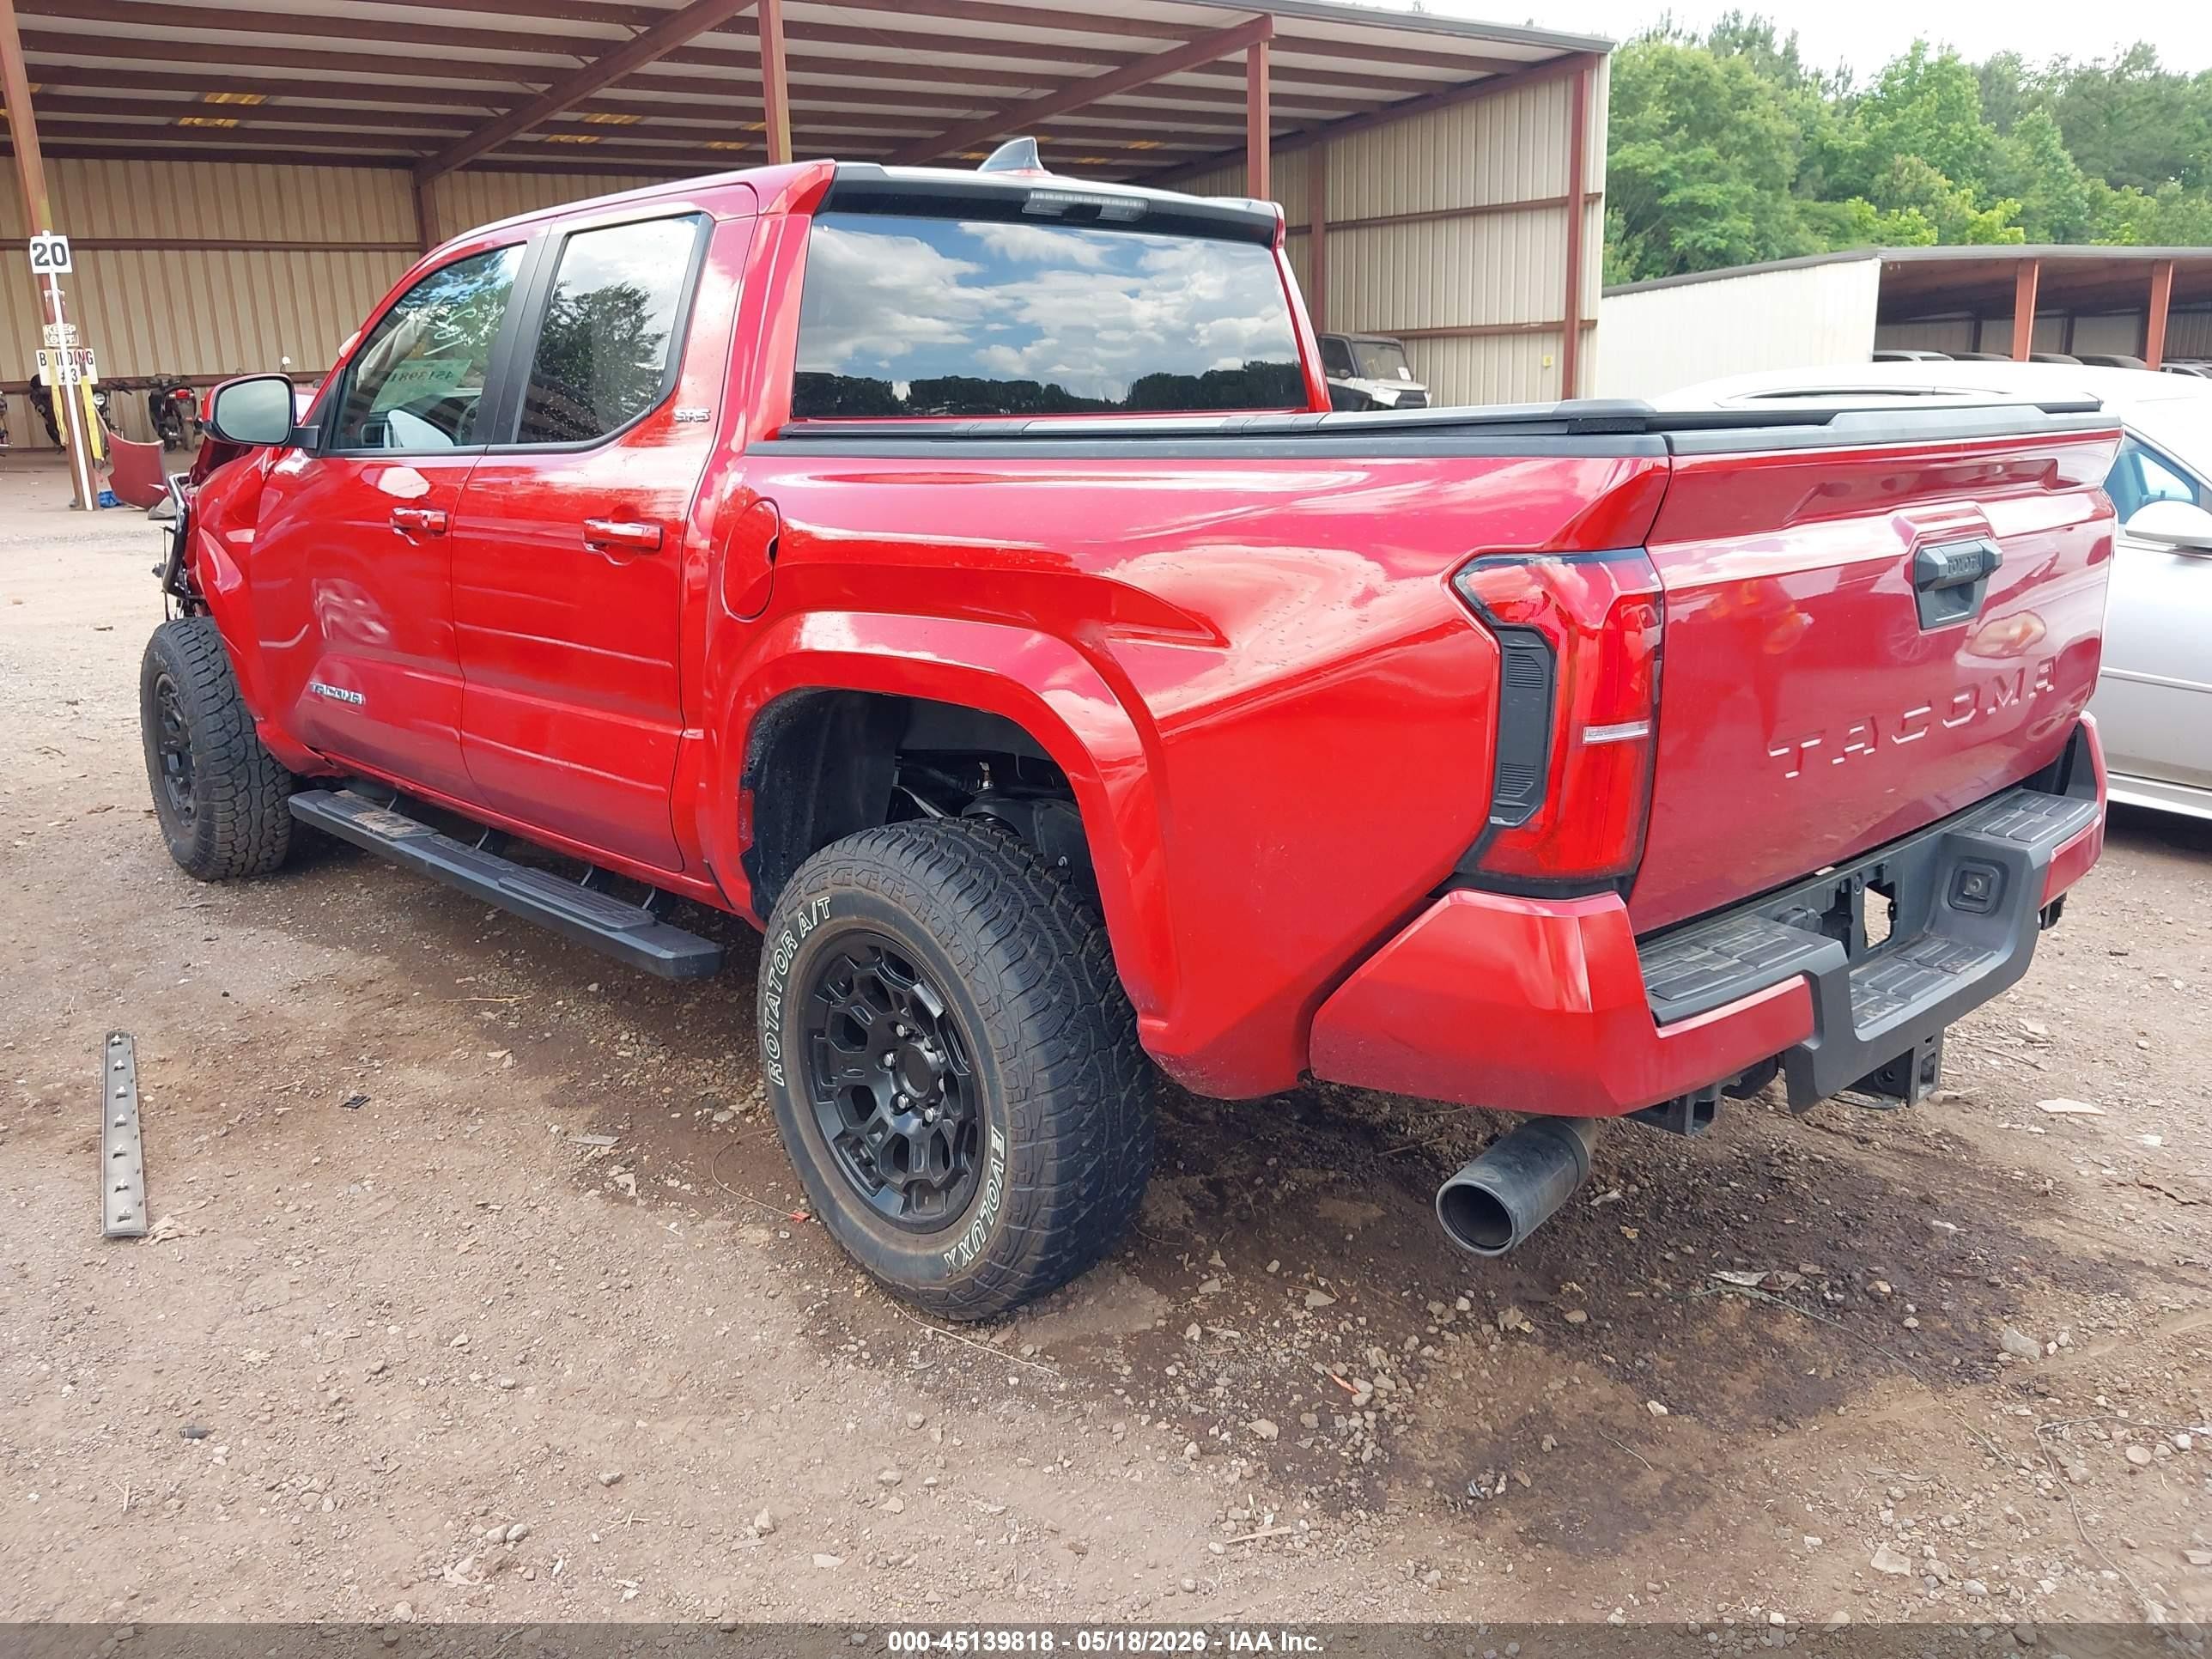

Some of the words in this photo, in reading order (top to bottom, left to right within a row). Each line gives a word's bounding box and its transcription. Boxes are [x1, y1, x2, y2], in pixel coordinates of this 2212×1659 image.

[32, 242, 67, 266] 20
[1767, 655, 2057, 779] TACOMA
[764, 929, 799, 1087] ROTATOR
[797, 896, 831, 939] A/T
[943, 1124, 1006, 1278] EVOLUXX
